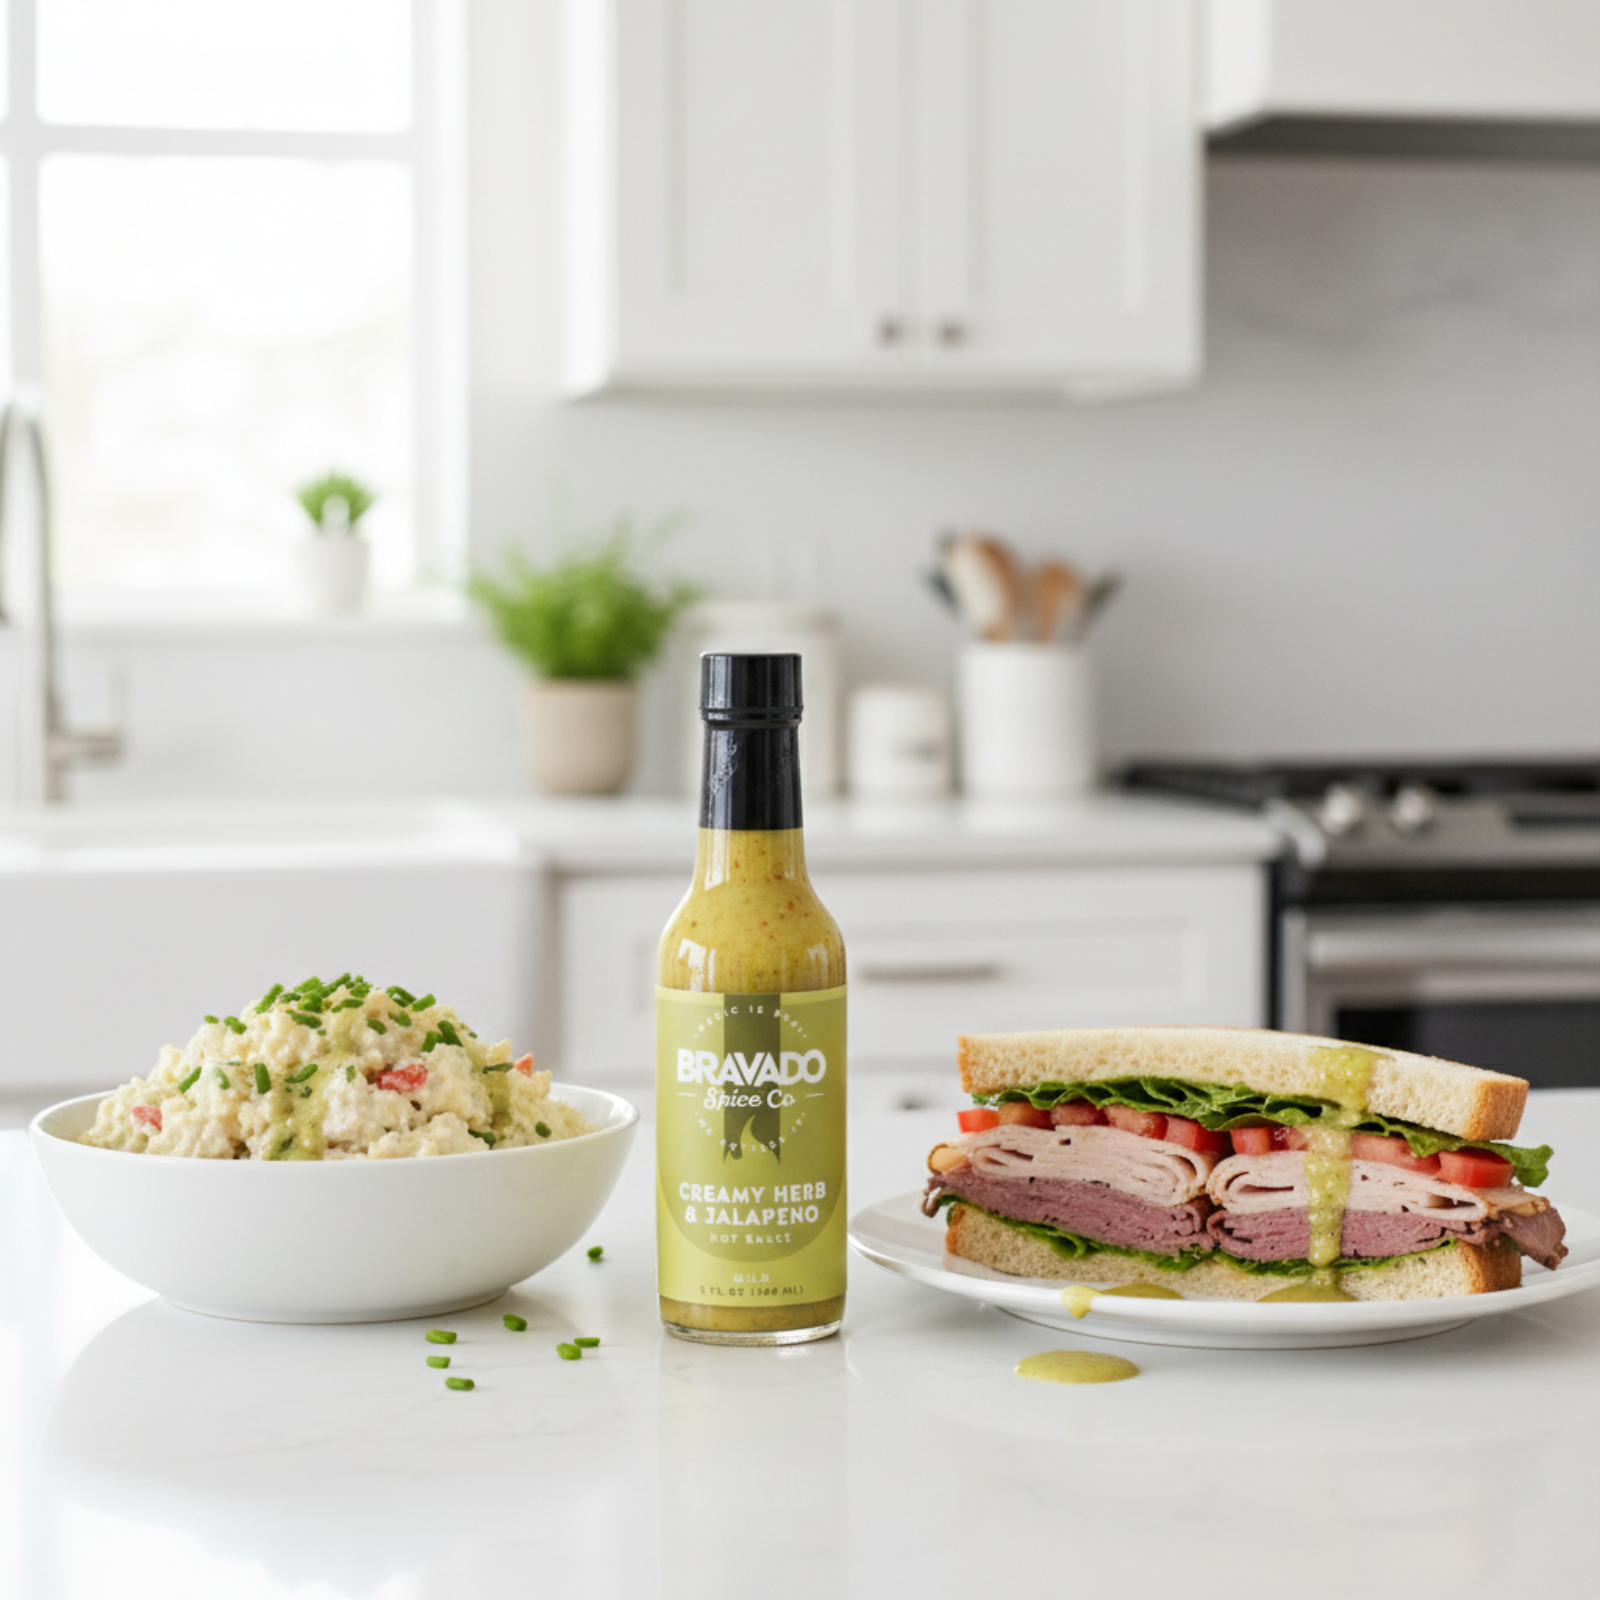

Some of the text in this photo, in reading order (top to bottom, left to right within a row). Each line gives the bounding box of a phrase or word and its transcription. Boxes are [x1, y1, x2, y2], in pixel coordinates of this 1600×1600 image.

[677, 1047, 827, 1087] BRAVADO
[679, 1181, 826, 1204] CREAMY HERB
[685, 1205, 820, 1226] & JALAPENO
